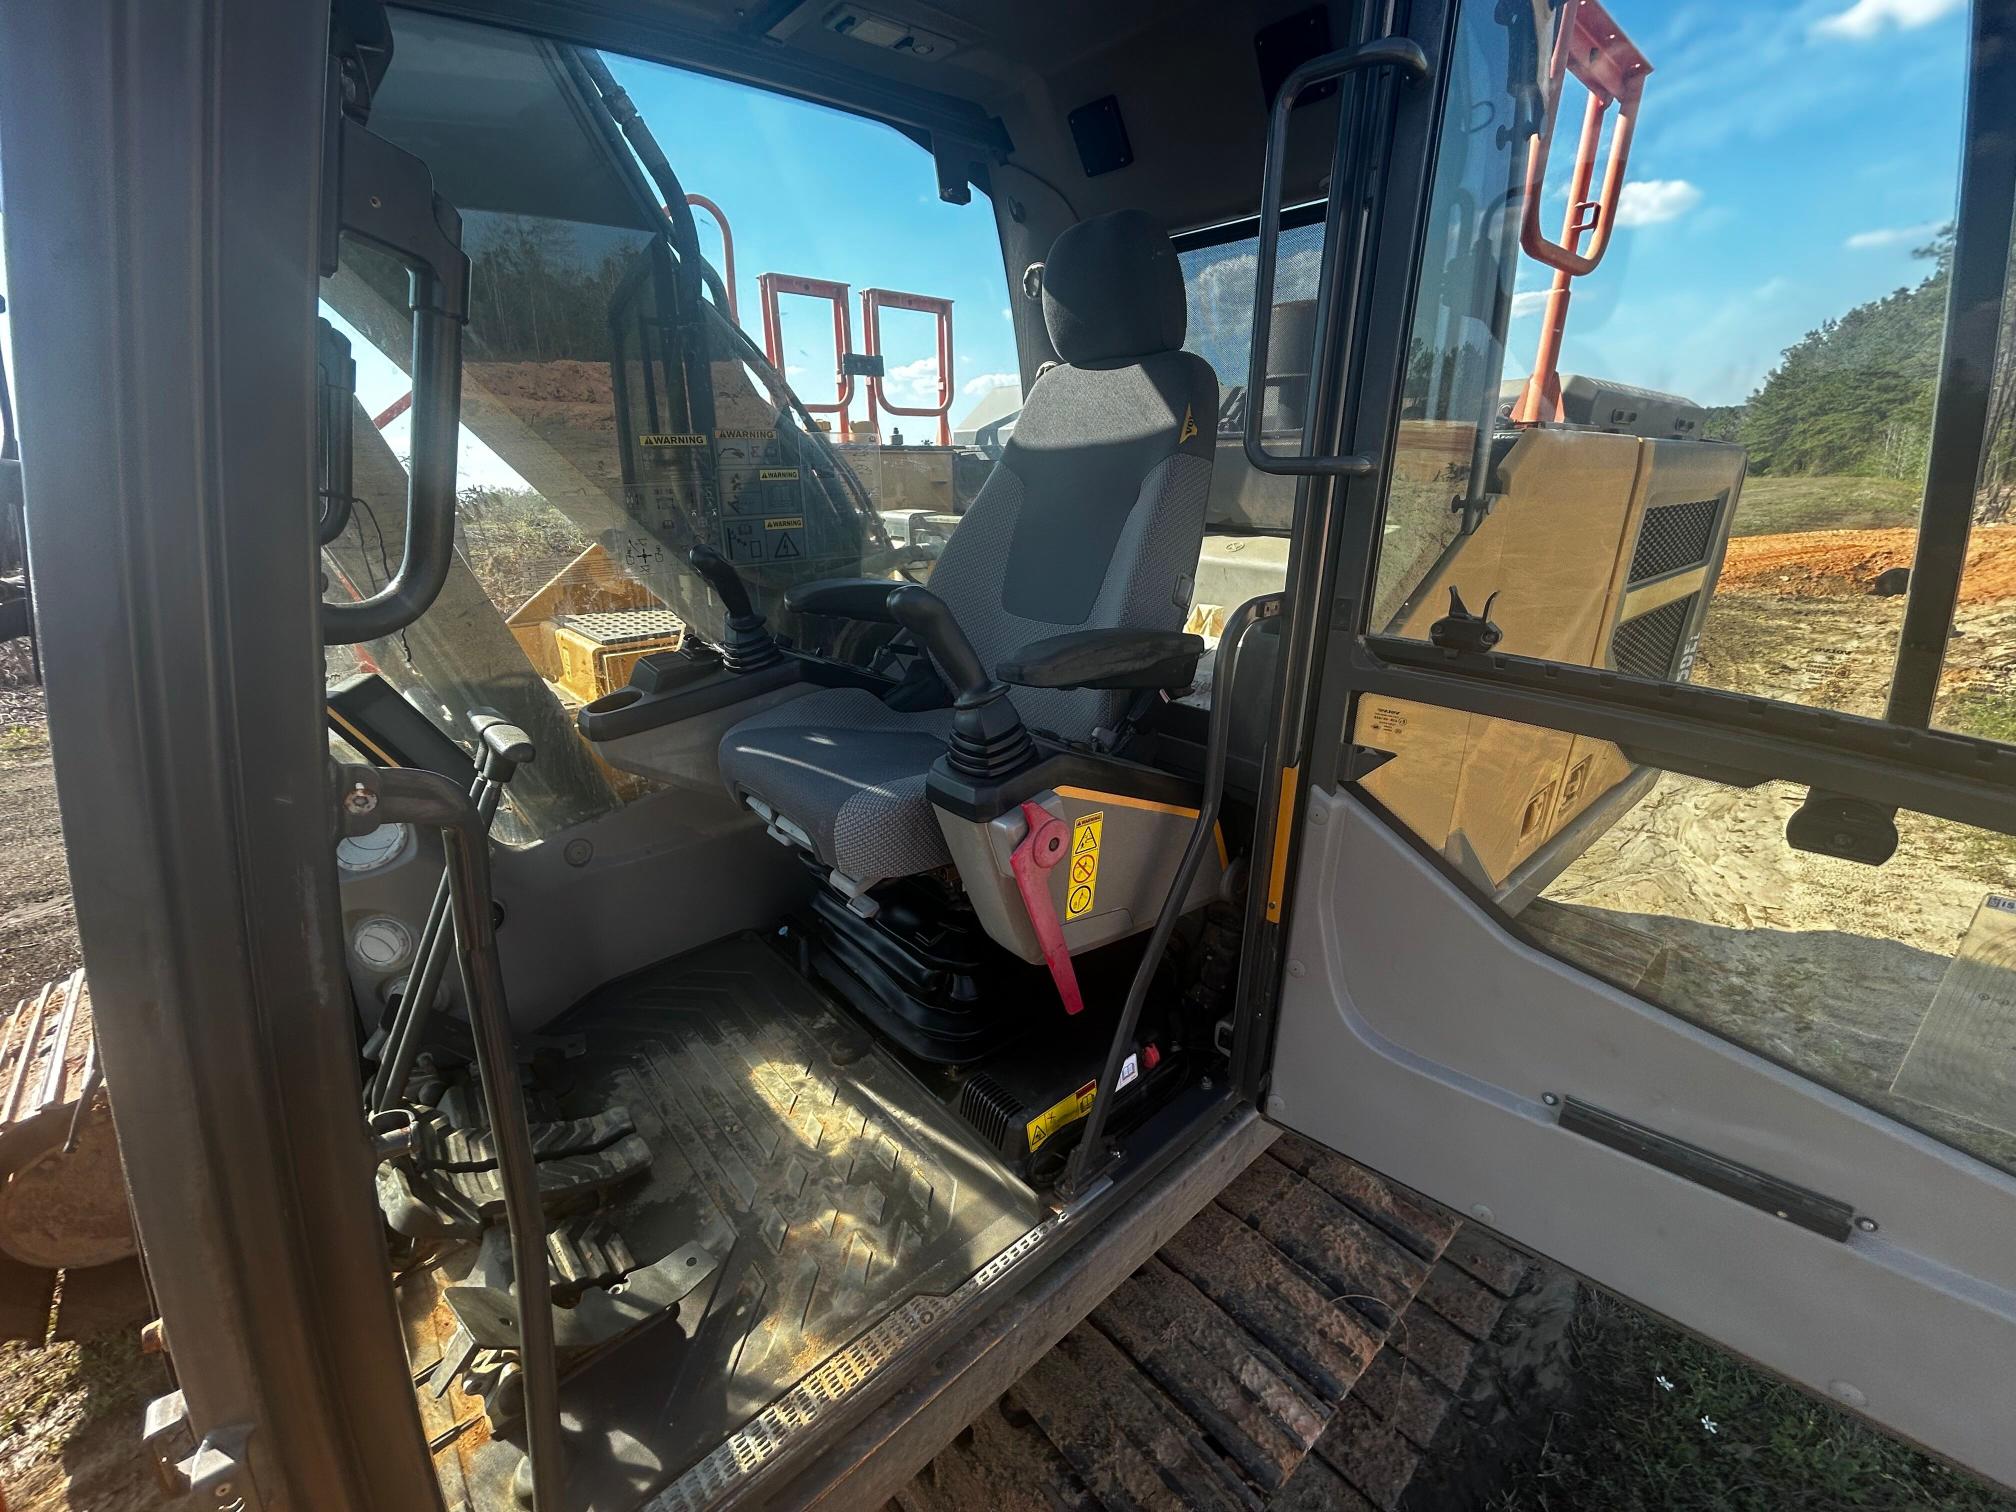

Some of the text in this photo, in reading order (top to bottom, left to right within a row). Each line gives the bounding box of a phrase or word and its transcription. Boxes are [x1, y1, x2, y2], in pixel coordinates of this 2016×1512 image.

[726, 430, 774, 438] WARNING
[653, 436, 704, 444] WARNING
[767, 471, 797, 479] WARNING
[772, 519, 802, 528] WARNING
